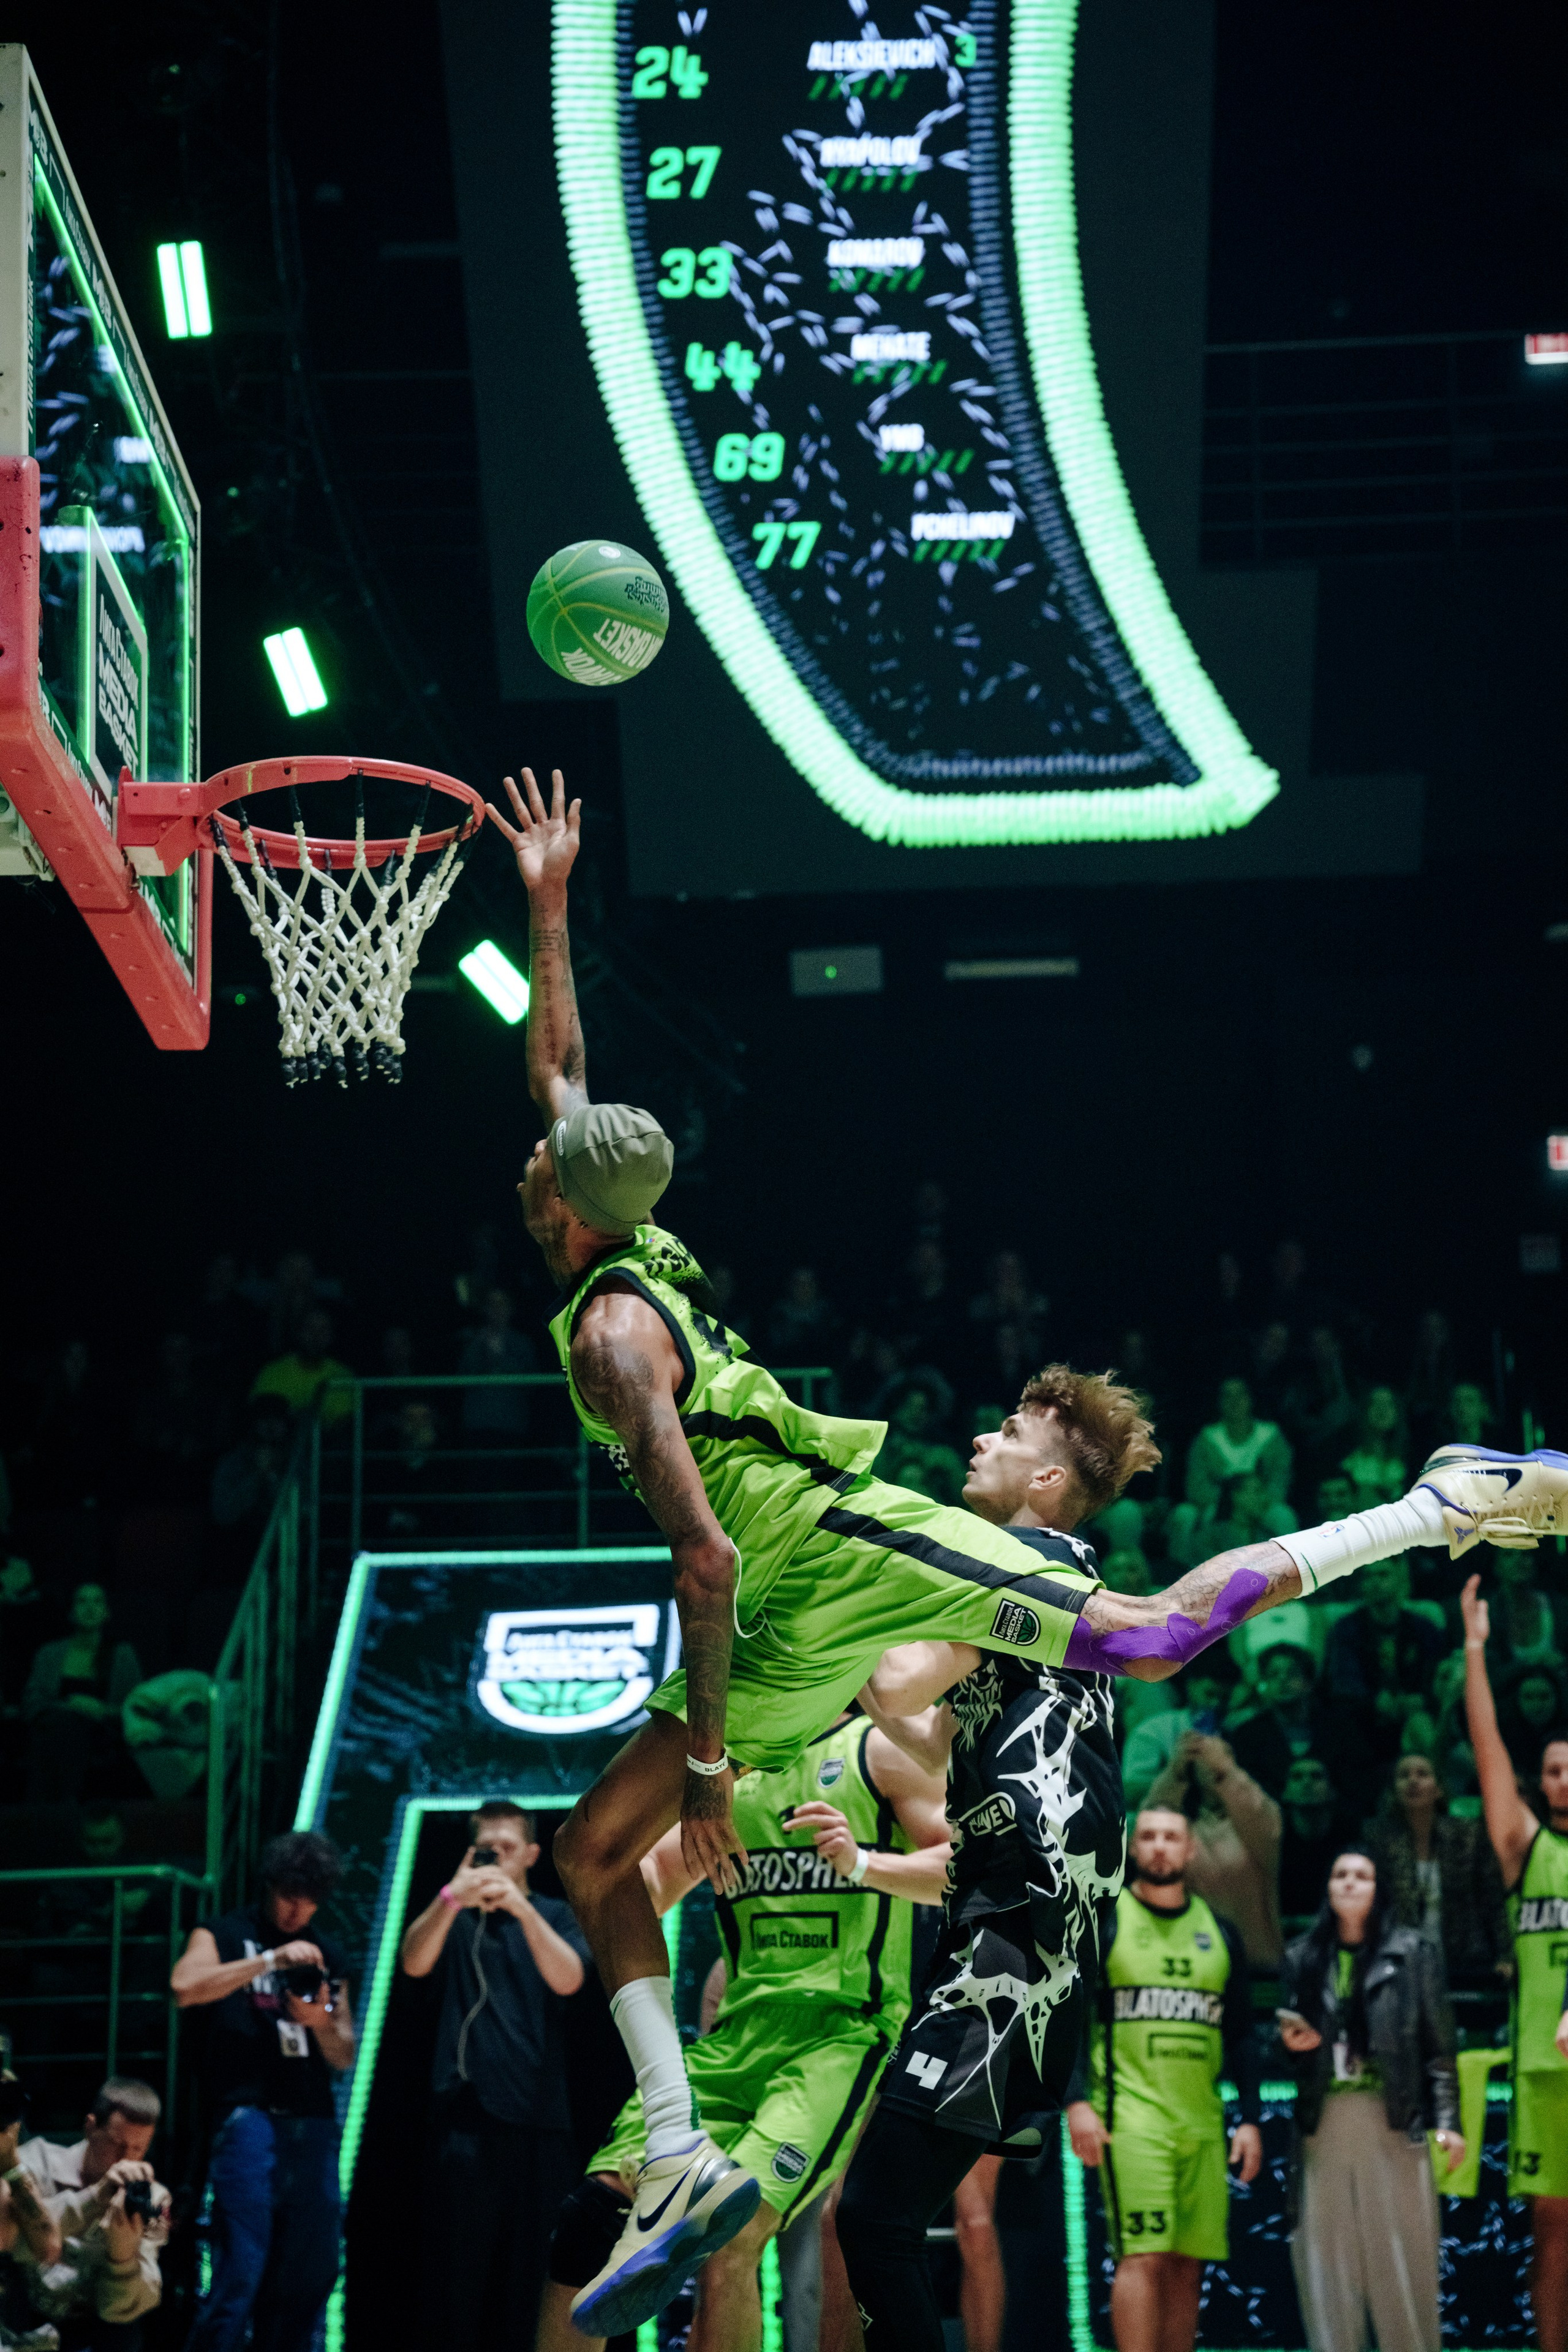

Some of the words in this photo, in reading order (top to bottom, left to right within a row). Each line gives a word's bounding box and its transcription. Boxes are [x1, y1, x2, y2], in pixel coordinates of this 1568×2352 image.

[631, 45, 709, 99] 24
[955, 34, 977, 67] 3
[646, 146, 722, 199] 27
[657, 246, 733, 298] 33
[685, 341, 761, 392] 44
[713, 432, 785, 482] 69
[753, 521, 822, 570] 77
[594, 618, 652, 667] BASKET
[99, 641, 138, 752] MEDIA
[99, 683, 138, 780] BASKET
[1005, 1607, 1022, 1641] MEDIA
[1011, 1608, 1027, 1643] BASKET
[1162, 1957, 1192, 1977] 33
[1126, 2210, 1168, 2236] 33
